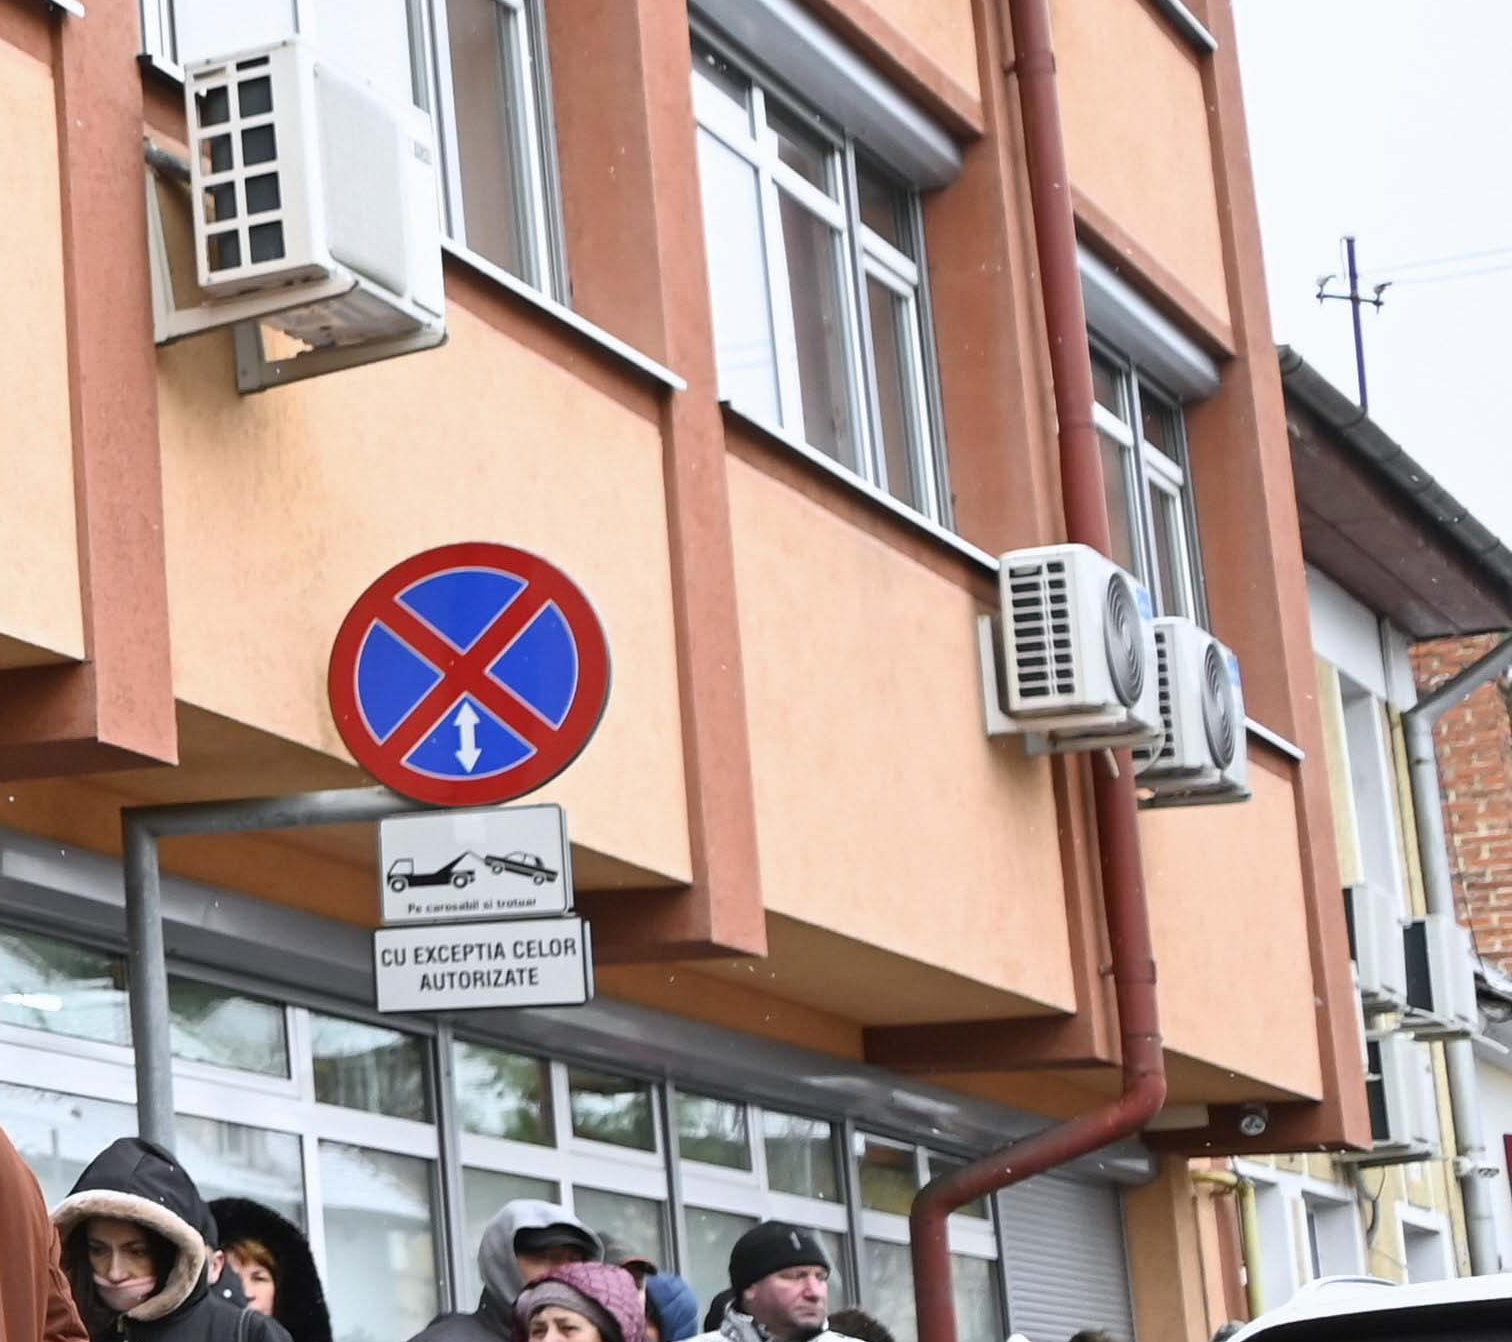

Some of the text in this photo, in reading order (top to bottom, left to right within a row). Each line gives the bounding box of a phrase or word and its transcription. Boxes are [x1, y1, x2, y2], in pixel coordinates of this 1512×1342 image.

[408, 903, 422, 914] Pe
[426, 898, 480, 913] carosabil
[500, 898, 537, 909] trotuar
[381, 936, 577, 967] CU EXCEPTIA CELOR
[420, 966, 540, 992] AUTORIZATE
